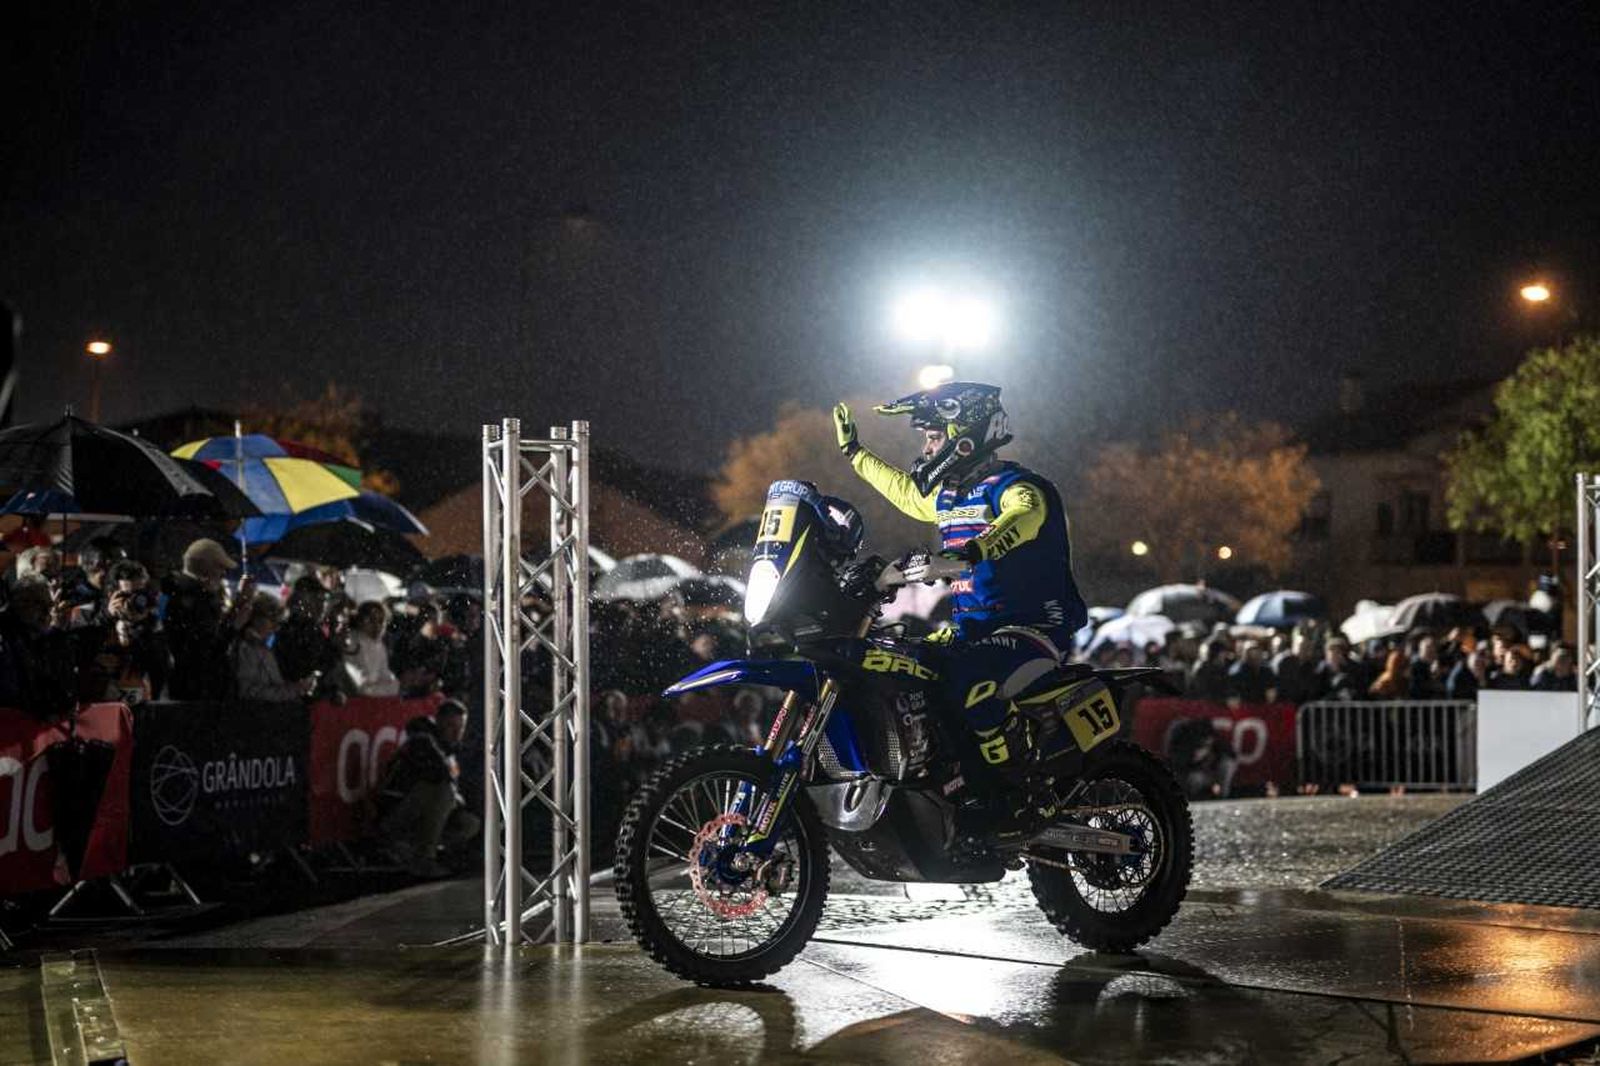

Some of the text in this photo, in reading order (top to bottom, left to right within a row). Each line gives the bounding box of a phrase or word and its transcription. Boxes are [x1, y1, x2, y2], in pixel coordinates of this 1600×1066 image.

[760, 509, 782, 536] 15
[1077, 699, 1114, 737] 15
[202, 751, 296, 793] GRÂNDOLA
